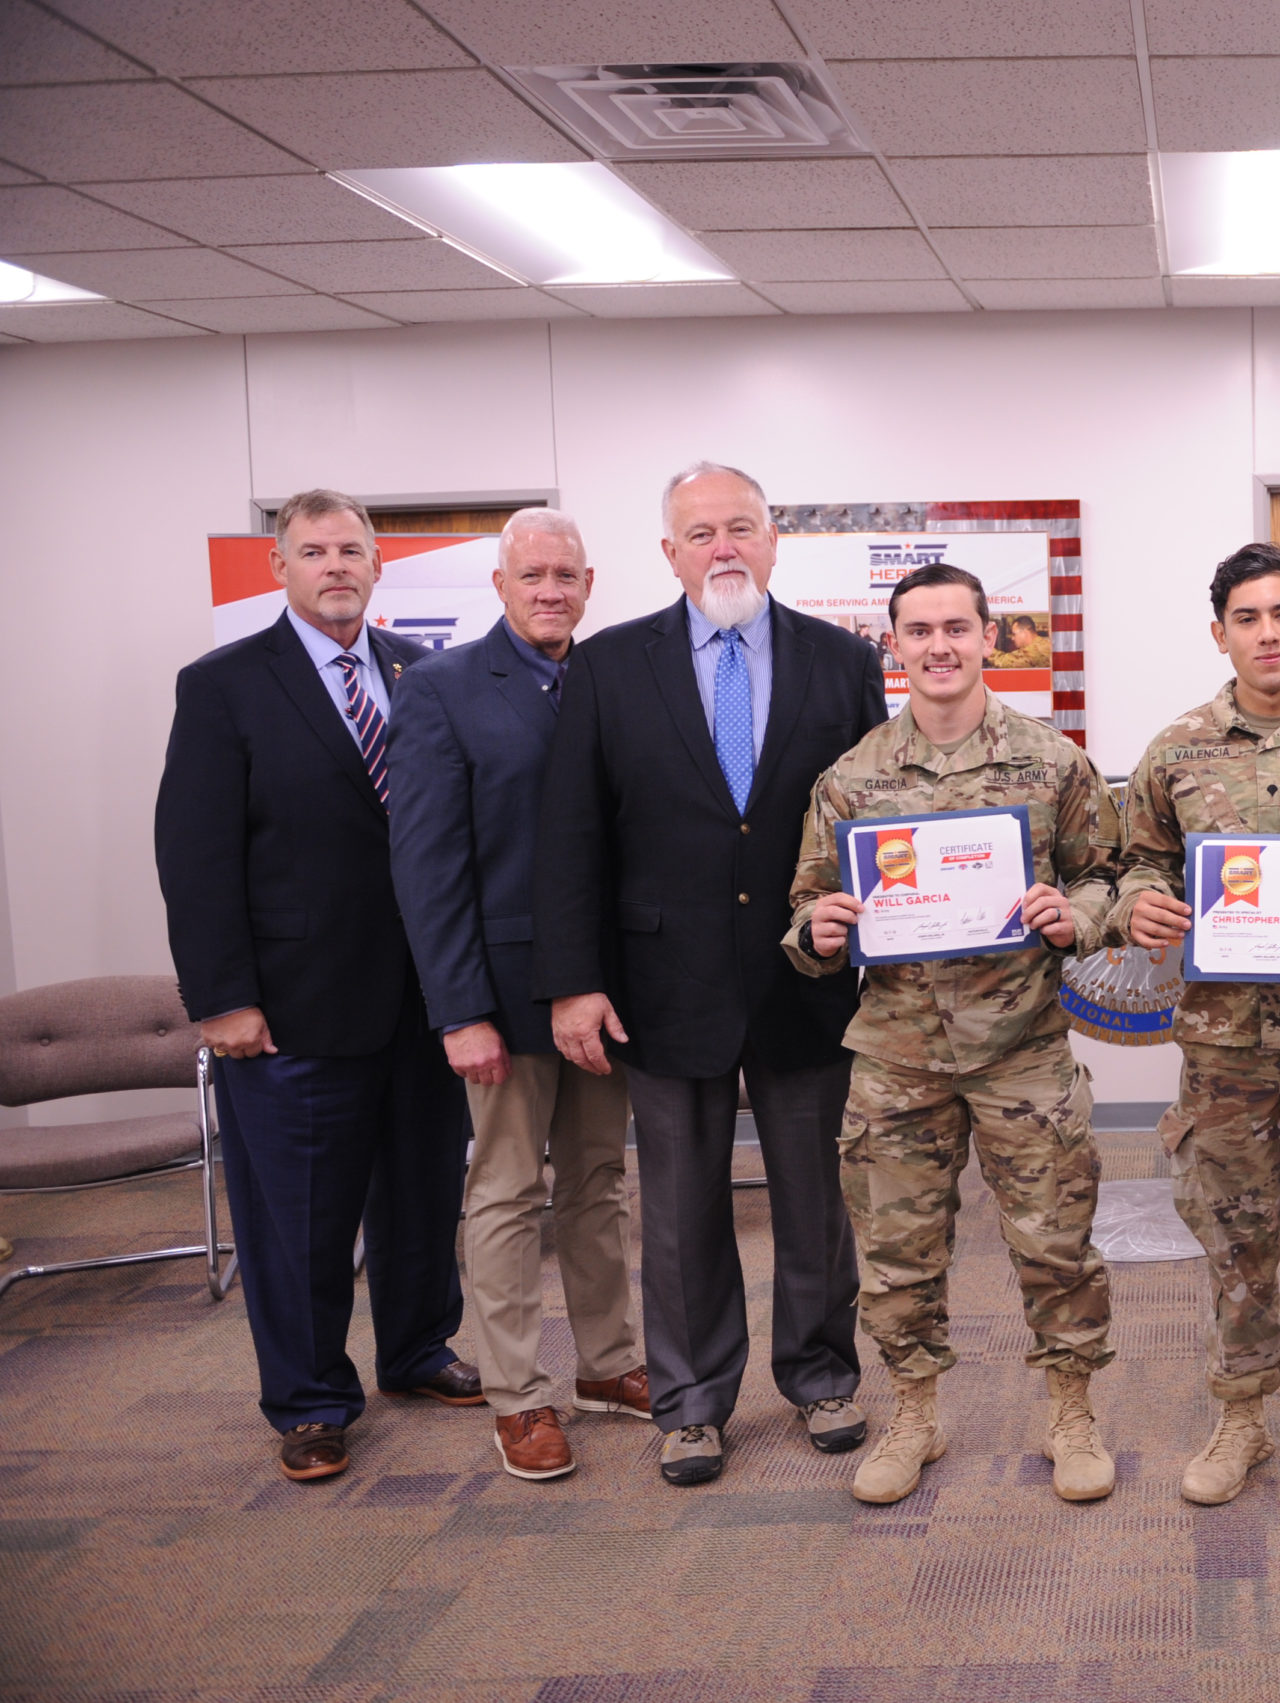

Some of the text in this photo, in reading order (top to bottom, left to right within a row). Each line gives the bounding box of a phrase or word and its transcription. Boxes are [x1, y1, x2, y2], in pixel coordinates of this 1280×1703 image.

[870, 553, 944, 566] SMART
[870, 569, 918, 581] HER
[796, 598, 824, 607] FROM
[826, 598, 869, 607] SERVING
[986, 595, 1024, 605] MERICA
[1175, 747, 1230, 760] VALENCIA
[1017, 770, 1048, 783] ARMY
[865, 779, 907, 790] GARCIA
[940, 842, 993, 856] CERTIFICATE
[874, 897, 903, 908] WILL
[906, 893, 951, 905] GARCIA
[1212, 915, 1280, 924] CHRISTOPHER
[1091, 978, 1116, 994] JAN
[1061, 993, 1133, 1029] ATIONAL
